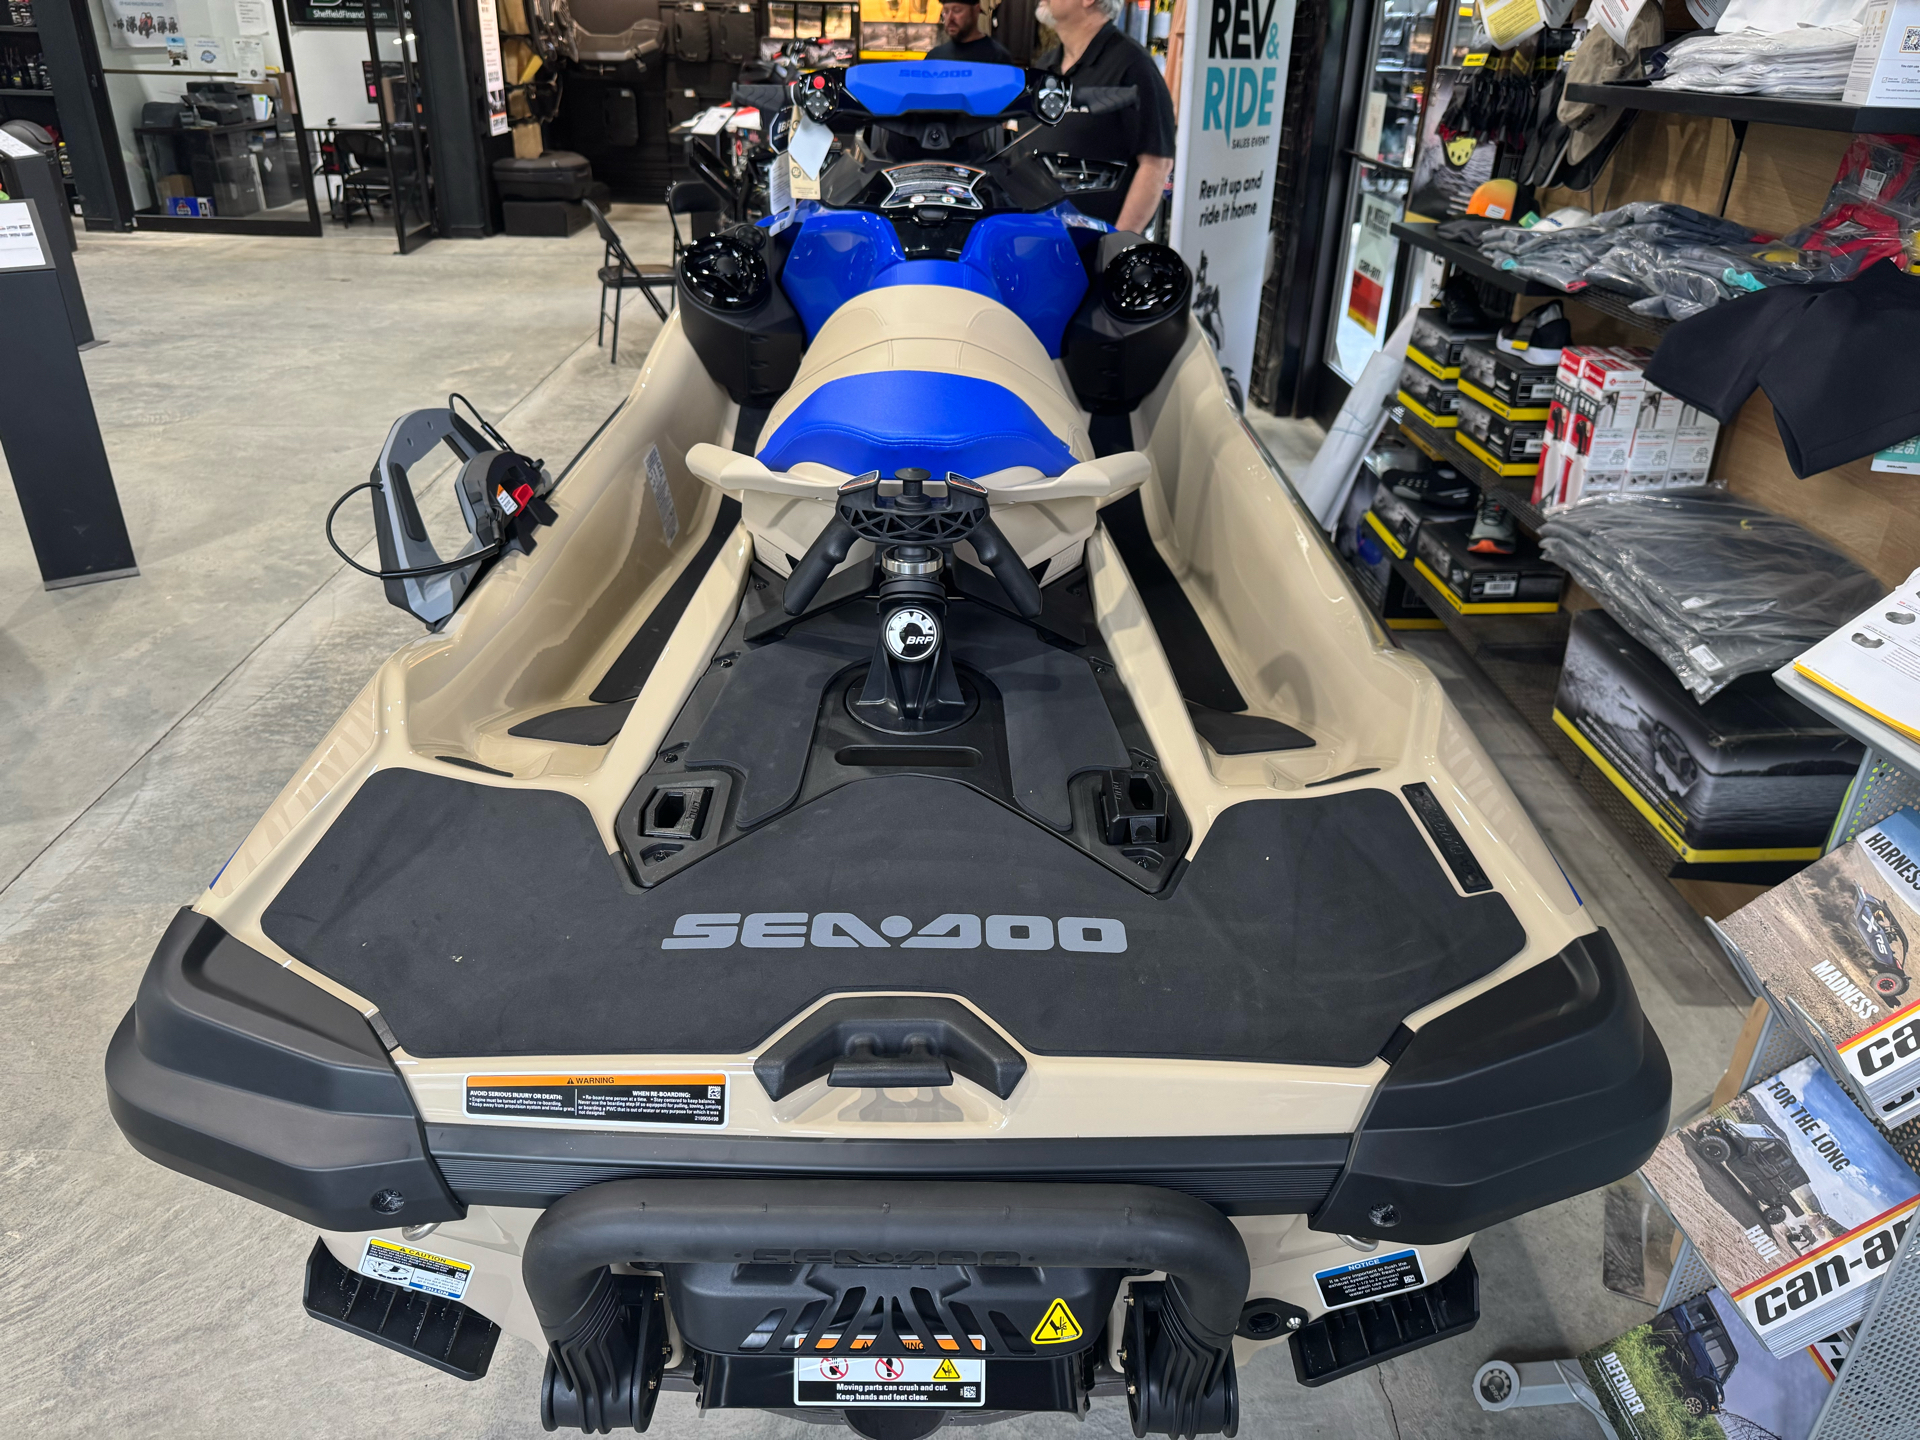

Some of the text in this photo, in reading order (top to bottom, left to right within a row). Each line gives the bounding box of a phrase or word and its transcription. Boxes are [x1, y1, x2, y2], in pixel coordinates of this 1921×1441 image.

[1208, 0, 1279, 60] REV &
[1202, 67, 1277, 148] RIDE
[1232, 136, 1271, 150] SALES EVENT
[1199, 170, 1264, 200] Rev it up and
[1199, 201, 1258, 227] ride it home
[906, 636, 934, 645] BRP
[1811, 959, 1880, 1019] MADNESS
[1768, 1080, 1851, 1173] FOR THE LONG
[409, 1249, 447, 1263] CAUTION
[1744, 1224, 1780, 1264] HAUL
[1328, 1280, 1350, 1289] exhaust
[1350, 1275, 1369, 1284] system
[1396, 1264, 1411, 1272] water
[1348, 1258, 1381, 1271] NOTICE
[1352, 1269, 1378, 1279] important
[836, 1383, 863, 1393] Moving
[864, 1384, 883, 1392] parts
[1602, 1351, 1646, 1416] DEFENDER
[836, 1393, 928, 1402] Keep hands and feet clear.
